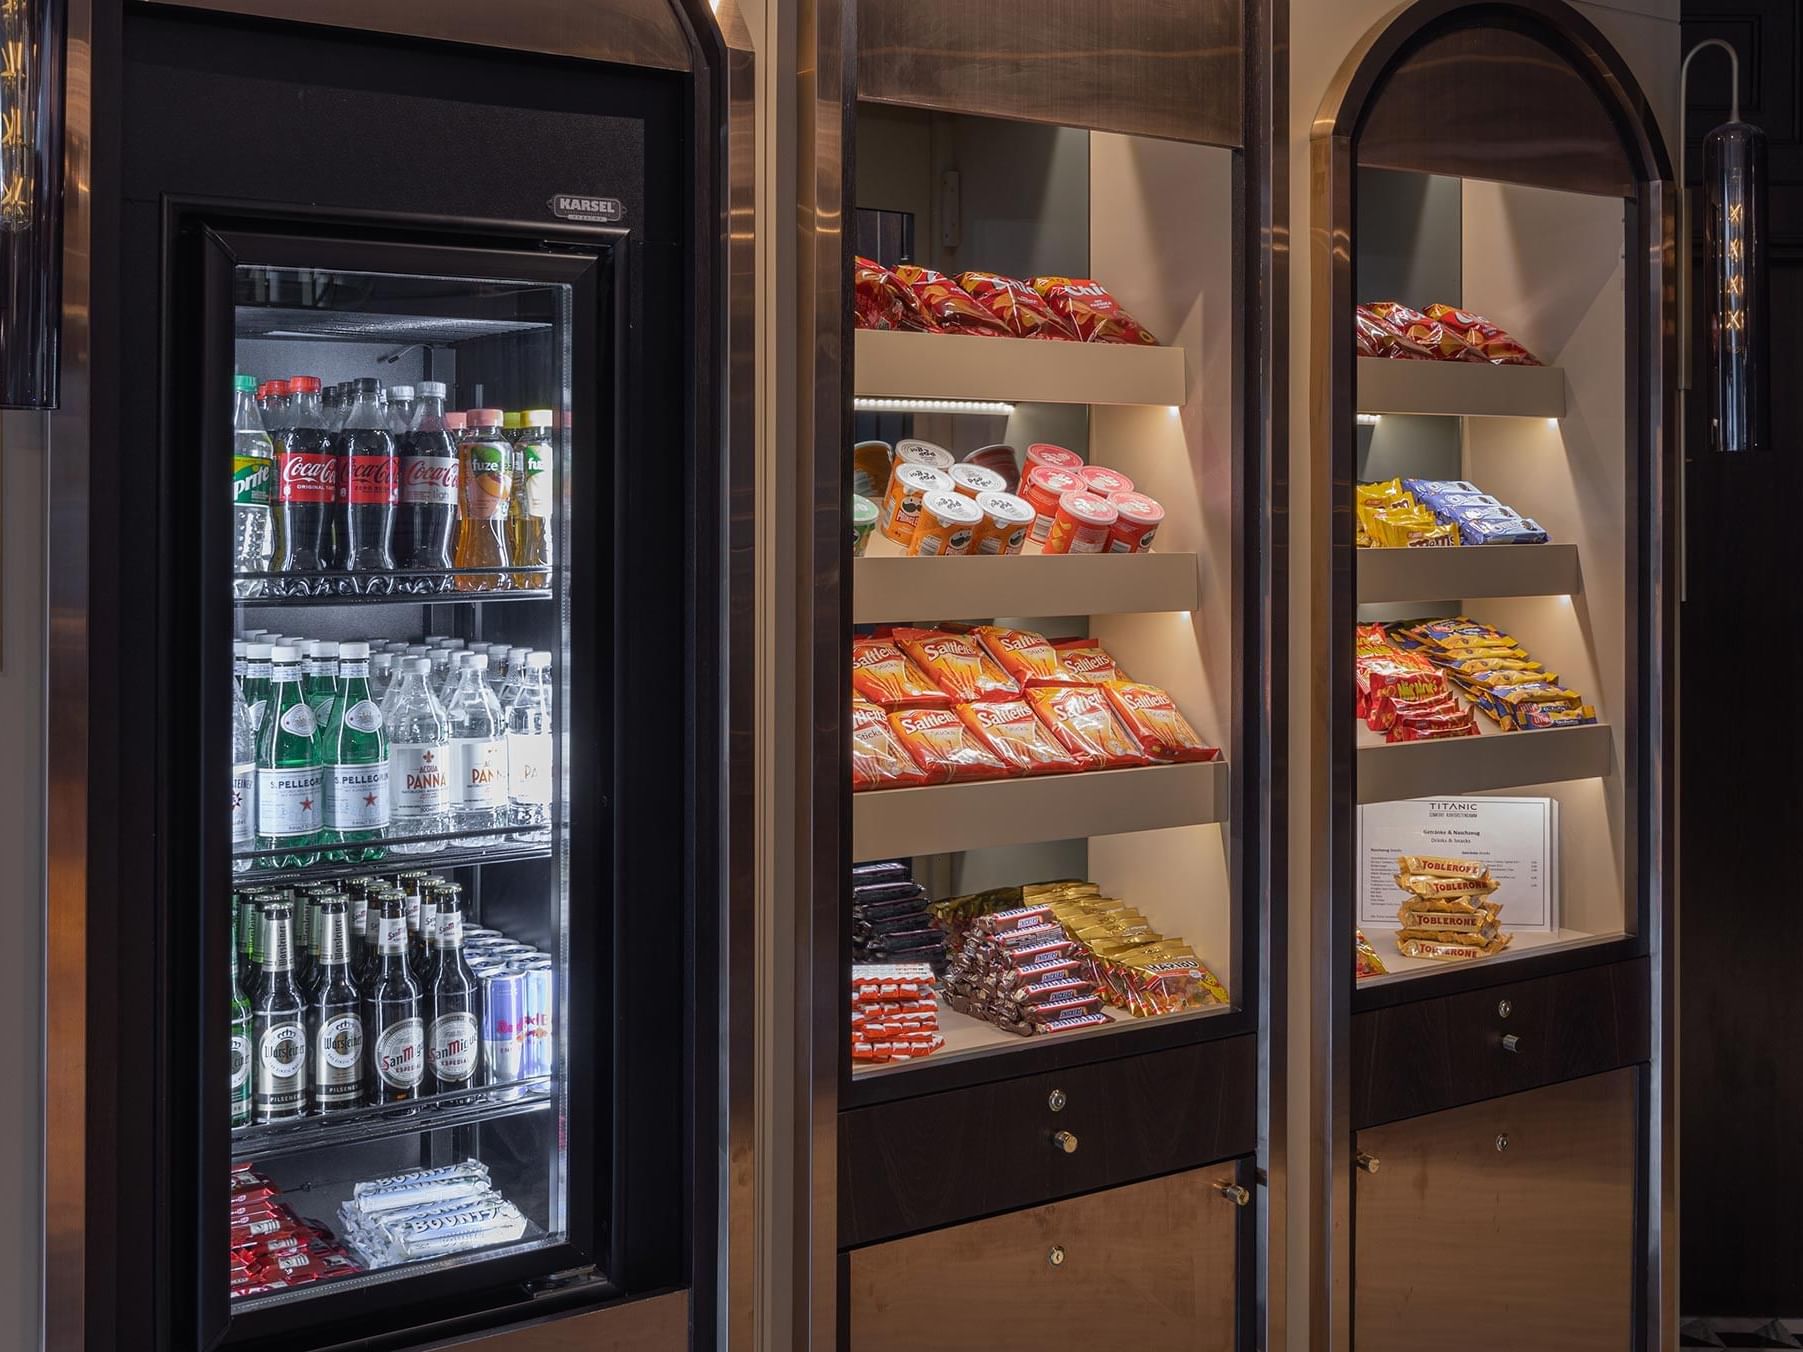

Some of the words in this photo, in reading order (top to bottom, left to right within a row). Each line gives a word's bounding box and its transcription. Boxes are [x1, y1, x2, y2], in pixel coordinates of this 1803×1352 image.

[560, 198, 615, 213] KARSEL
[472, 458, 498, 471] fuze
[1064, 654, 1111, 674] Saltletts
[856, 729, 884, 741] Sticks
[407, 772, 446, 790] PANNA
[1429, 802, 1478, 811] TITANIC
[1433, 881, 1488, 893] TOBLERONE
[1416, 914, 1477, 927] TOBLERONE
[278, 926, 288, 967] Warsteiner
[1146, 960, 1199, 971] HARIBO
[411, 1208, 498, 1234] BOUNTY
